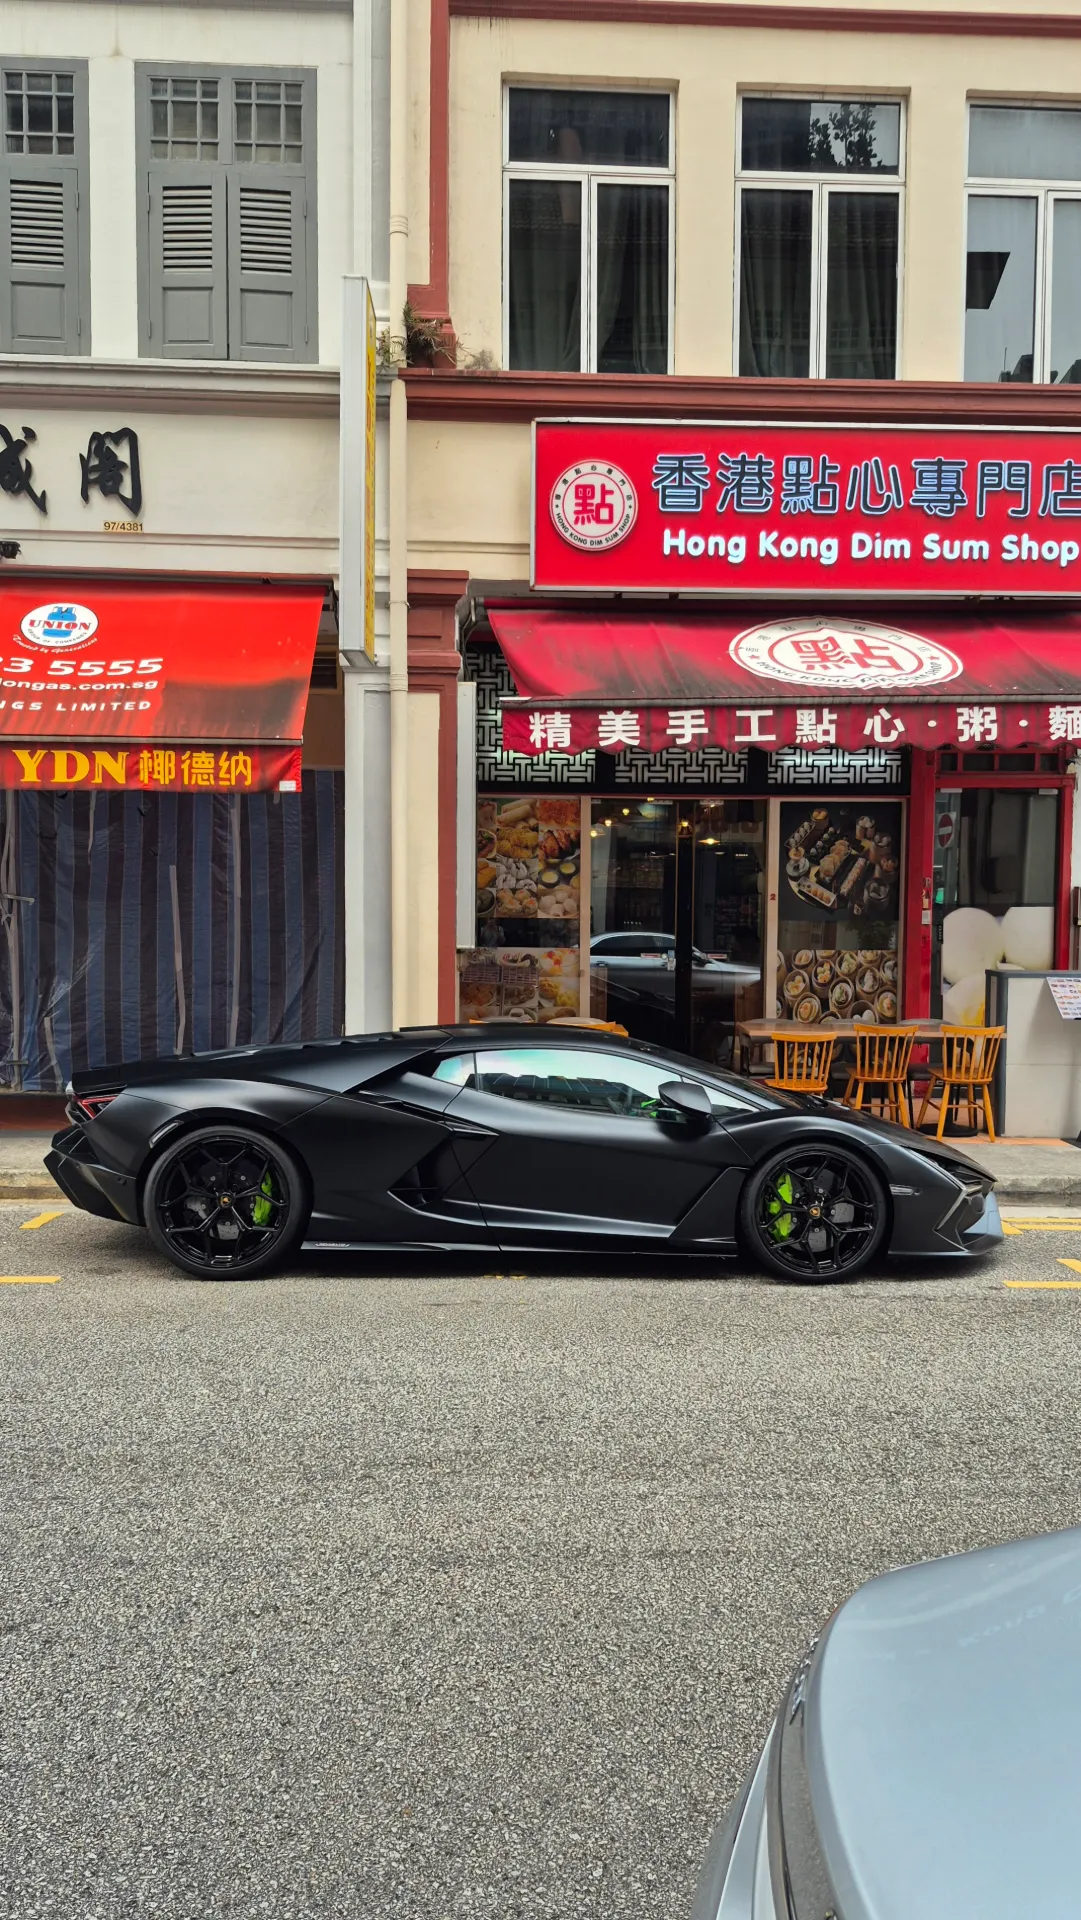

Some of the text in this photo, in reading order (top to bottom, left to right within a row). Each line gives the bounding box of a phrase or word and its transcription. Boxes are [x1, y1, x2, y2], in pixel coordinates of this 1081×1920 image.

[651, 452, 1081, 519] 香港點心專門店
[573, 483, 614, 526] 點
[103, 522, 144, 532] 97/4381
[556, 513, 569, 533] HONG
[569, 532, 588, 545] KONG
[604, 531, 620, 543] SUM
[618, 513, 631, 533] SHOP
[662, 528, 1080, 567] Hong Kong Dim Sum Shop
[28, 619, 92, 631] UNION
[0, 656, 164, 676] 3 5555
[0, 678, 159, 691] ongas.com.sg
[56, 701, 152, 712] LIMITED
[11, 748, 130, 785] YDN
[139, 749, 253, 787] 椰德纳
